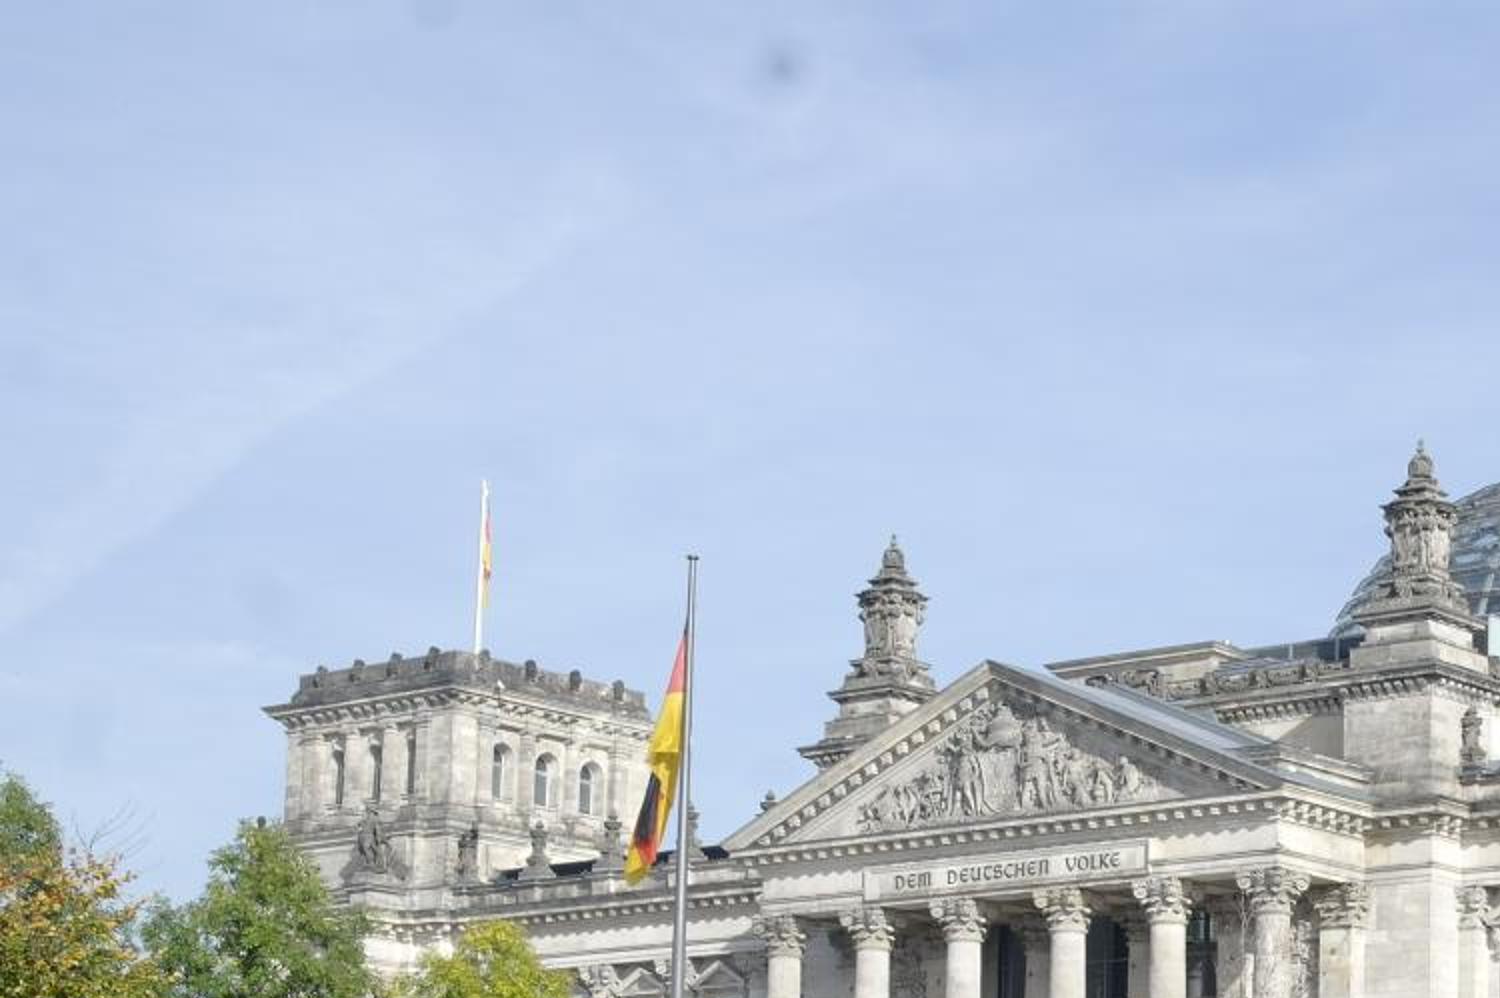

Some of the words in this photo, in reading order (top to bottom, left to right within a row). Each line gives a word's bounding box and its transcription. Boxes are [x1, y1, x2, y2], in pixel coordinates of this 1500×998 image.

[894, 872, 932, 890] DEM
[946, 858, 1050, 884] DEUTSCHEN
[1064, 851, 1121, 872] VOLKE
